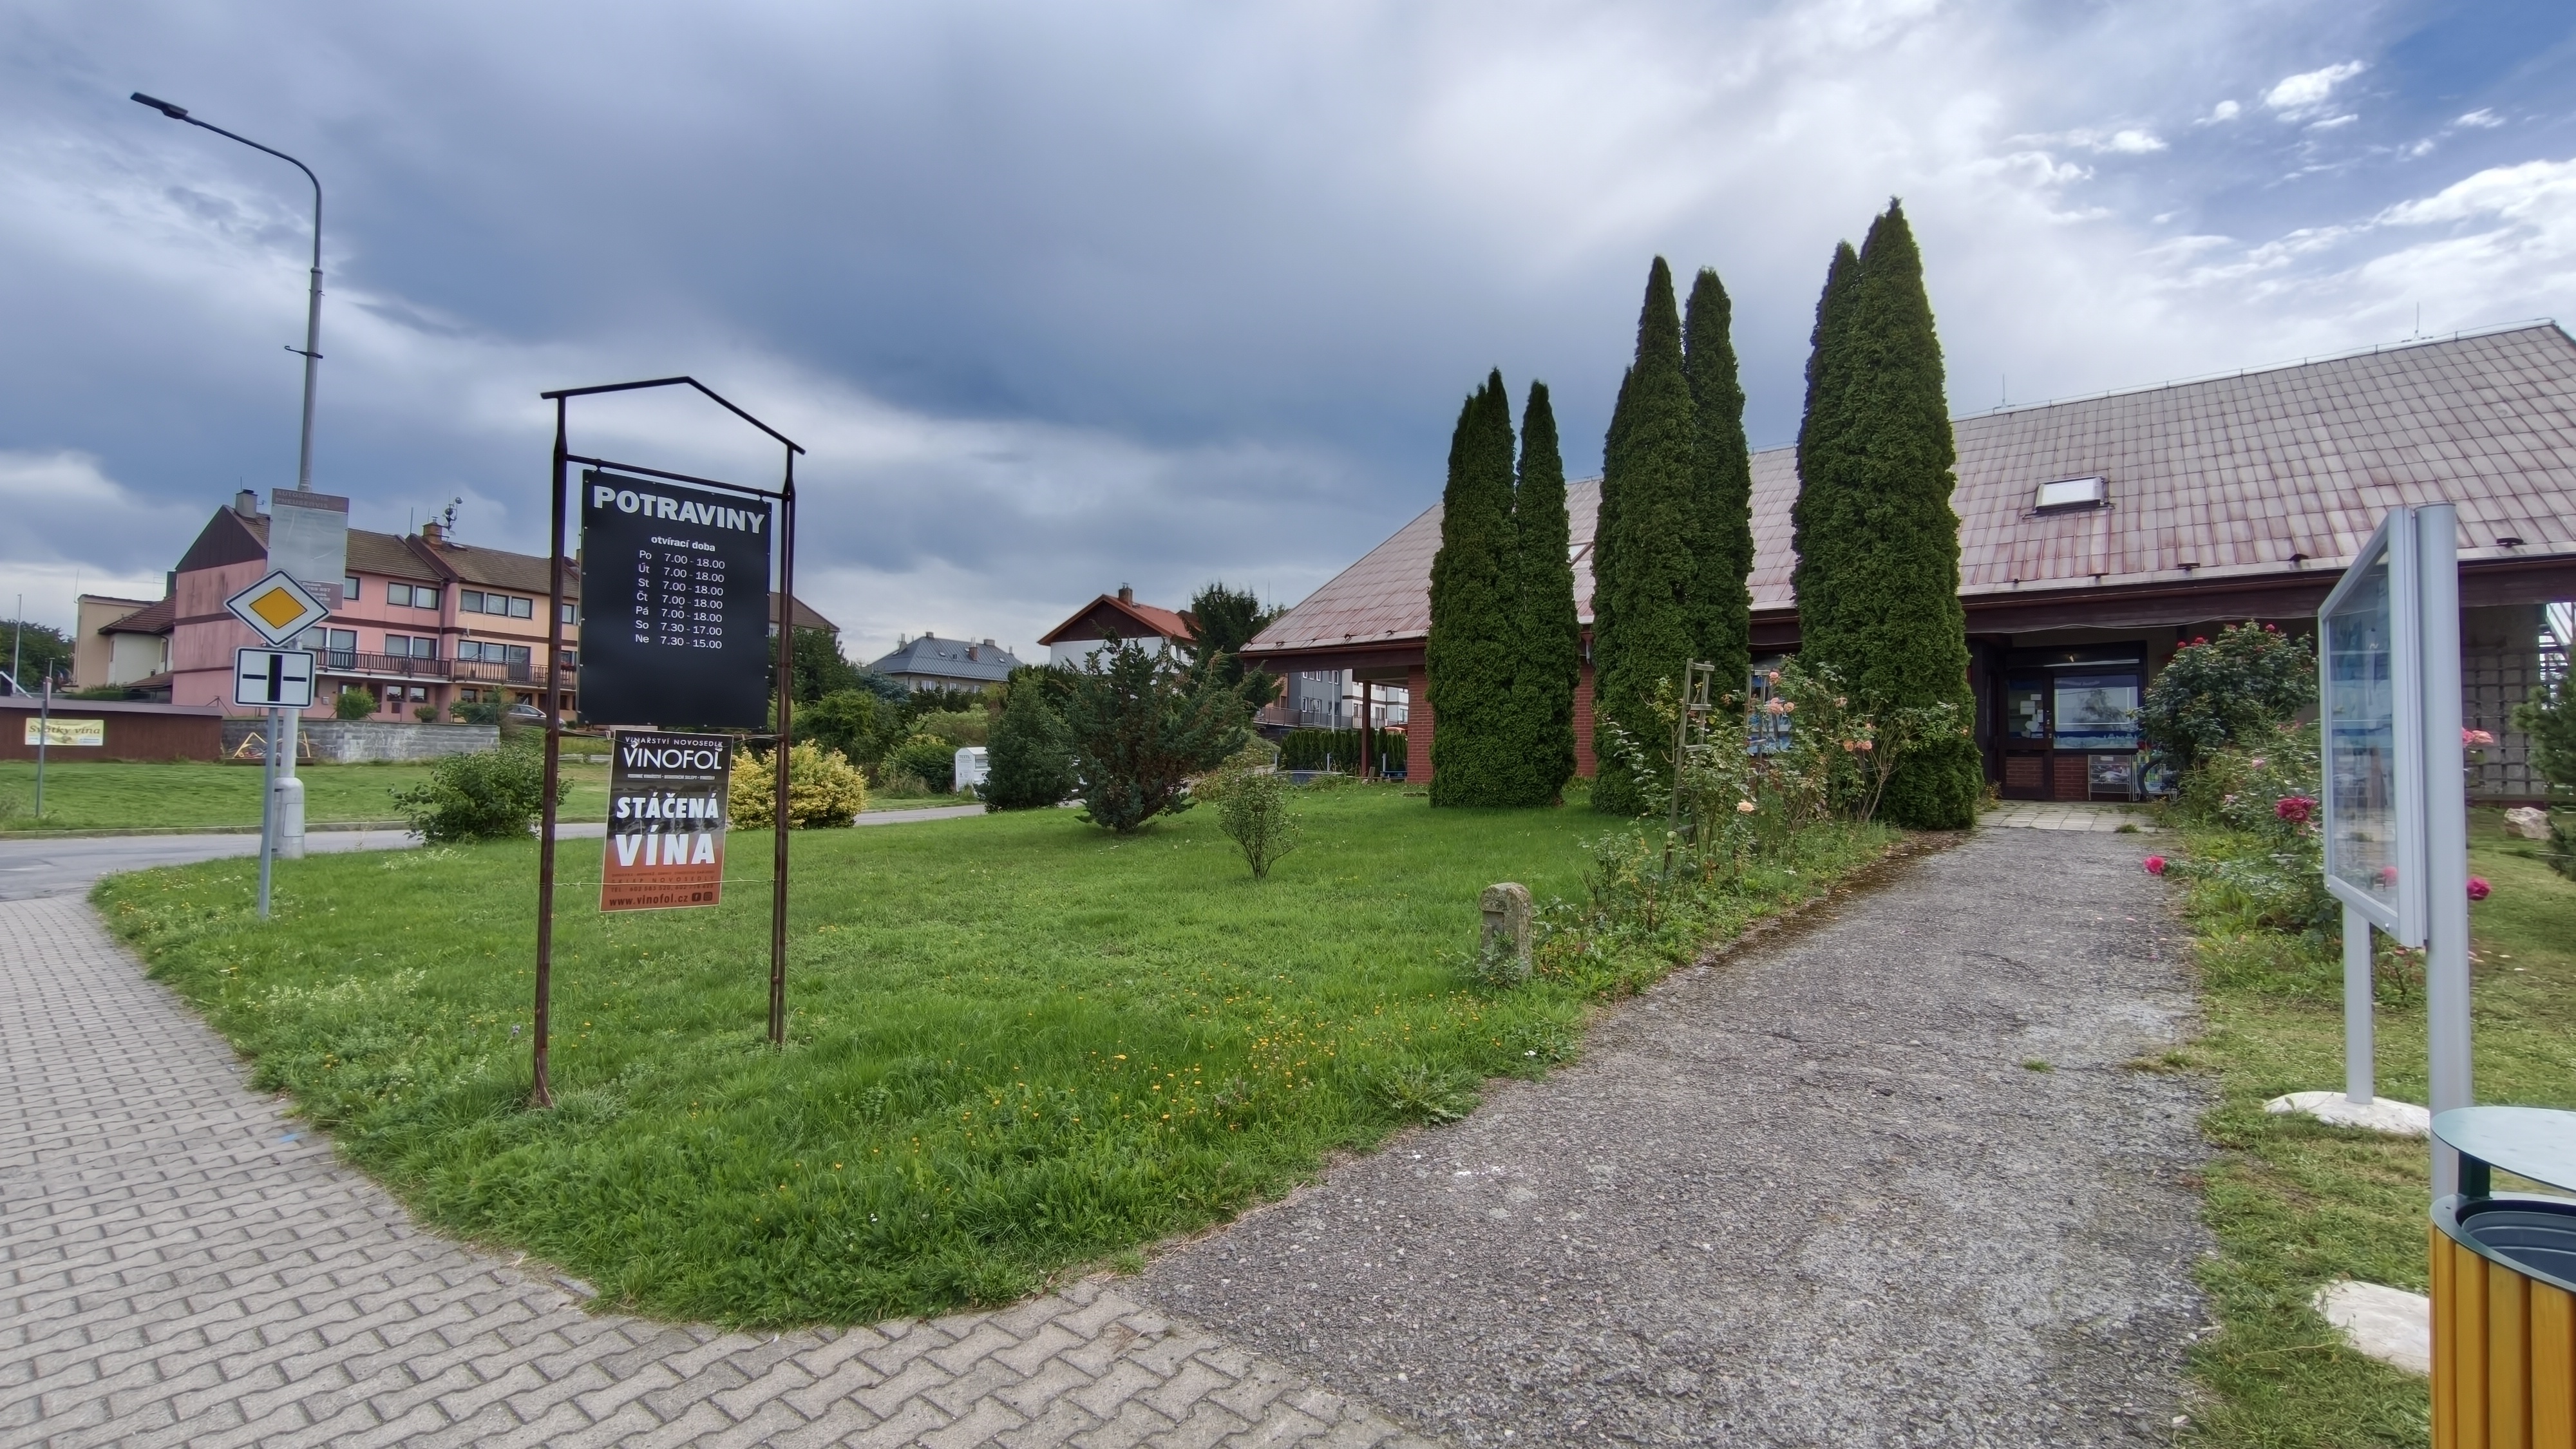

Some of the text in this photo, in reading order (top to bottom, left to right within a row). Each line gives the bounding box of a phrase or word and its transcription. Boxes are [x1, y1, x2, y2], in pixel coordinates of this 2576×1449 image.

[593, 485, 765, 534] POTRAVINY
[650, 536, 715, 552] otvírací doba
[639, 550, 652, 560] Po
[664, 553, 688, 564] 7.00
[696, 558, 725, 569] 18.00
[638, 562, 650, 573] Út
[663, 567, 687, 578] 7.00
[696, 571, 724, 583] 18.00
[638, 578, 649, 587] St
[663, 581, 686, 591] 7.00
[694, 585, 723, 596] 18.00
[636, 590, 648, 601] Čt
[662, 594, 685, 605] 7.00
[694, 599, 723, 609] 18.00
[636, 606, 649, 615] Pá
[661, 609, 685, 619] 7.00
[693, 612, 723, 622] 18.00
[635, 620, 649, 629] So
[660, 622, 684, 632] 7.30
[693, 625, 722, 636] 17.00
[635, 634, 650, 643] Ne
[660, 636, 684, 646] 7.30
[693, 639, 722, 649] 15.00
[28, 725, 71, 735] Svátky
[625, 736, 670, 744] VINAŘSTVÍ
[623, 747, 722, 770] VINOFOL
[616, 791, 719, 819] STÁČENÁ
[615, 824, 715, 867] VÍNA
[609, 893, 688, 906] www.vinofol.cz
